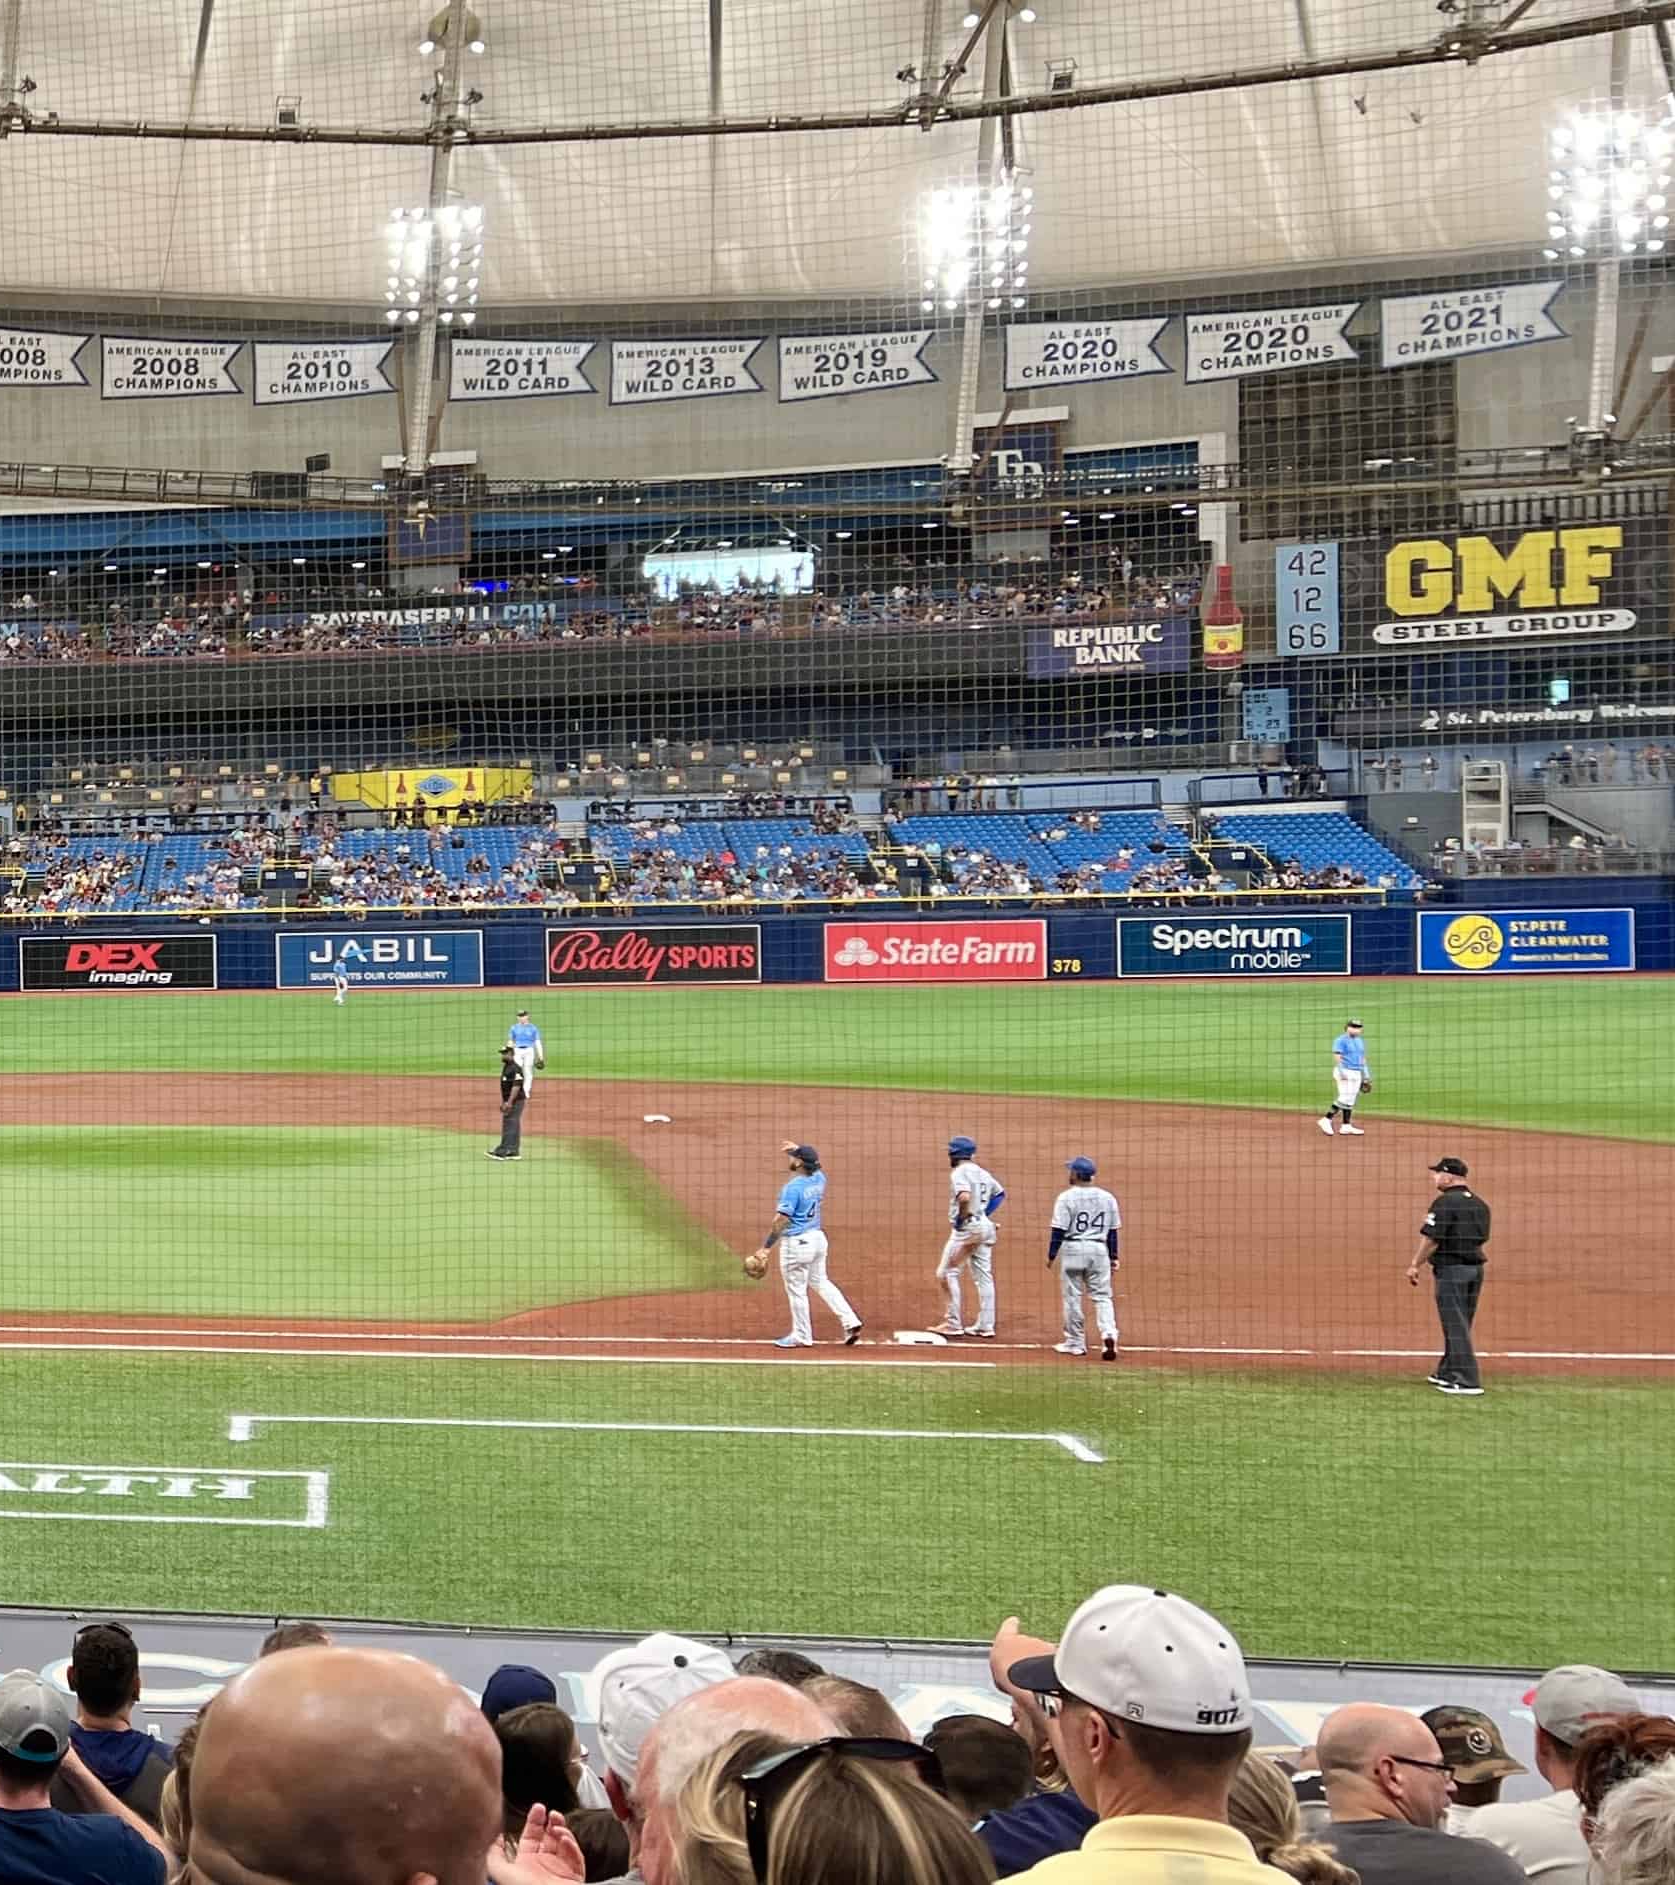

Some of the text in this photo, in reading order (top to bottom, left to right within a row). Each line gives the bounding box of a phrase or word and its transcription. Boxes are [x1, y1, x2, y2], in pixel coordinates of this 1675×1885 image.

[1430, 290, 1505, 310] AL EAST
[1191, 308, 1343, 334] AMERICAN LEAGUE
[1420, 304, 1503, 336] 2021
[10, 336, 43, 346] EAST
[1049, 326, 1112, 339] AL EAST
[1223, 325, 1310, 353] 2020
[1398, 325, 1536, 355] CHAMPIONS
[107, 347, 225, 356] AMERICAN LEAGUE
[291, 350, 346, 360] AL EAST
[455, 346, 581, 356] AMERICAN LEAGUE
[617, 344, 747, 359] AMERICAN LEAGUE
[785, 334, 918, 356] AMERICAN LEAGUE
[1042, 339, 1118, 363] 2020
[132, 358, 200, 376] 2008
[485, 358, 550, 376] 2011
[646, 357, 715, 378] 2013
[814, 349, 888, 373] 2019
[1200, 345, 1334, 371] CHAMPIONS
[286, 360, 352, 380] 2010
[794, 367, 909, 390] WILD CARD
[1022, 359, 1139, 379] CHAMPIONS
[114, 378, 219, 390] CHAMPIONS
[269, 379, 370, 395] CHAMPIONS
[463, 377, 570, 391] WILD CARD
[625, 376, 736, 394] WILD CARD
[1288, 551, 1327, 576] 42
[1385, 526, 1623, 617] GMF
[1293, 586, 1322, 613] 12
[1053, 624, 1164, 647] REPUBLIC
[1289, 623, 1327, 649] 66
[1392, 613, 1617, 640] STEEL GROUP
[1076, 644, 1142, 664] BANK
[1447, 712, 1473, 724] St.
[1479, 708, 1593, 723] Petersburg
[1153, 924, 1302, 956] Spectrum
[1509, 935, 1609, 947] CLEARWATER
[65, 943, 164, 971] DEX
[309, 938, 449, 963] JABIL
[551, 932, 755, 981] Bally SPORTS
[364, 972, 386, 980] OUR
[1052, 959, 1081, 973] 378
[88, 970, 173, 984] imaging
[1076, 1211, 1105, 1233] 84
[1196, 1707, 1238, 1725] 907
